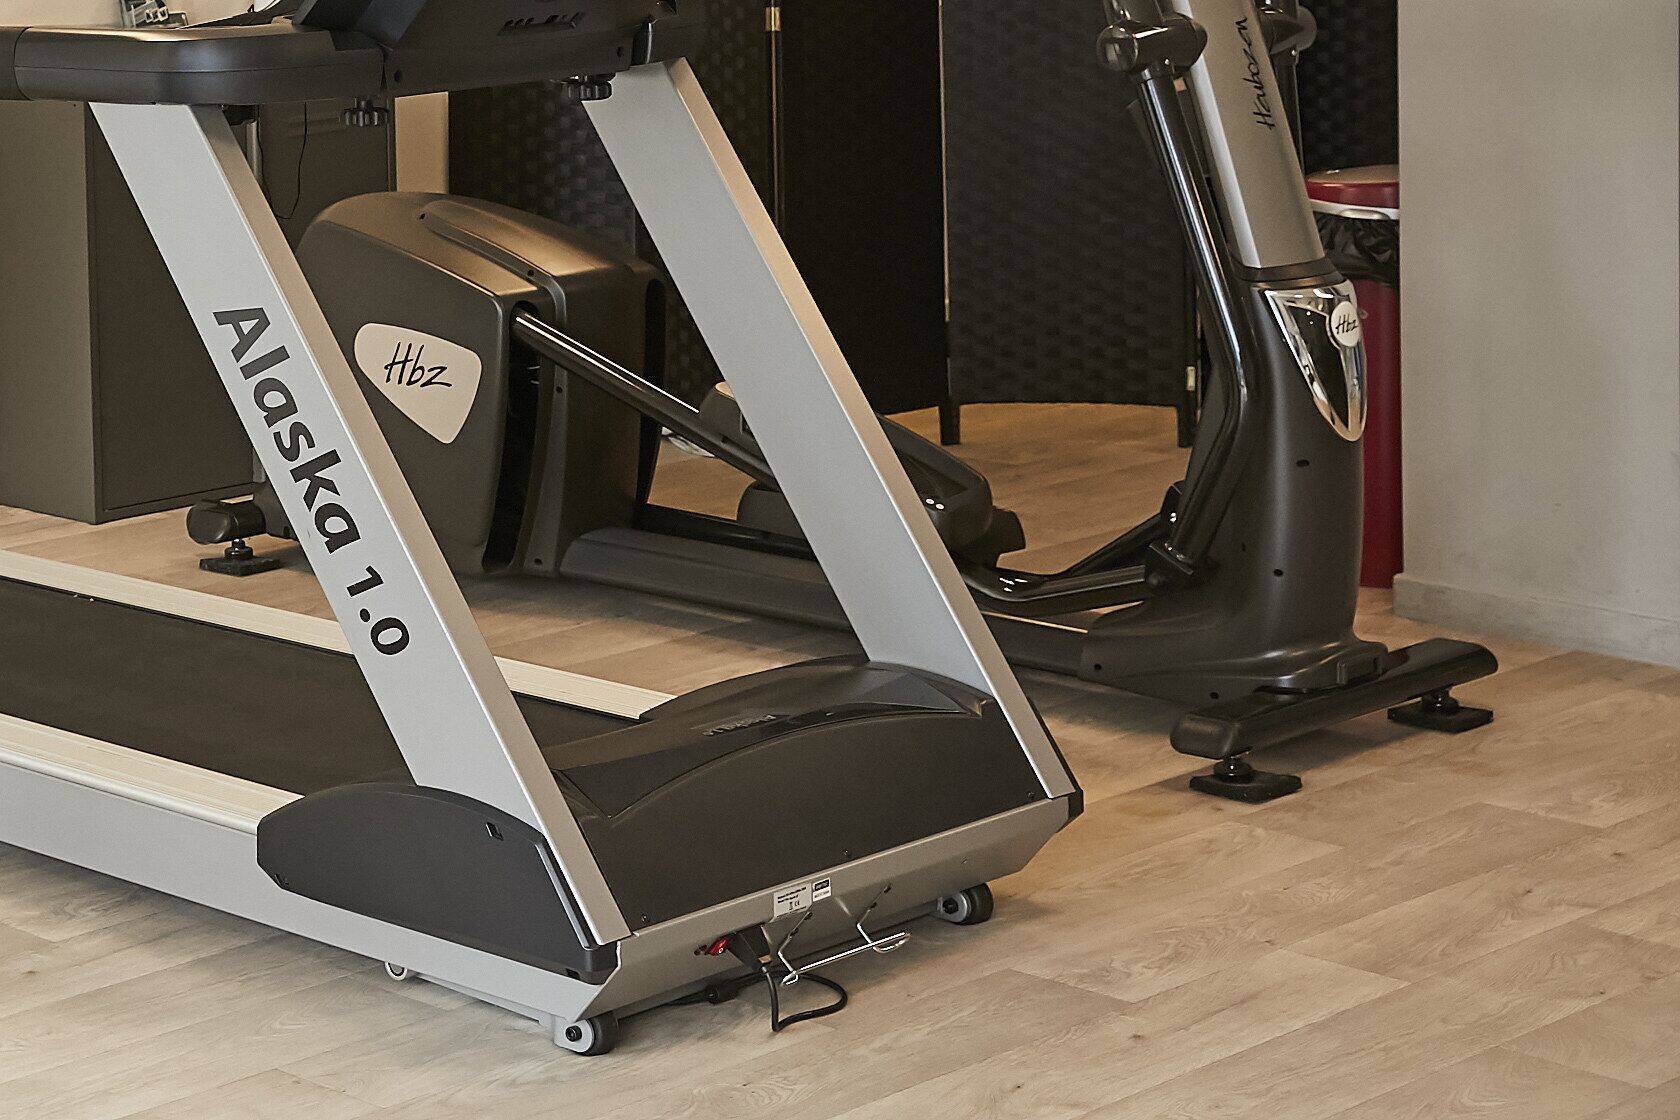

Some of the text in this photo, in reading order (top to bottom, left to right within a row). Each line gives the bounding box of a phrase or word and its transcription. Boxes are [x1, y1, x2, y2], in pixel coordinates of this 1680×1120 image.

[383, 341, 453, 388] Hbz
[212, 306, 410, 656] Alaska 1.0
